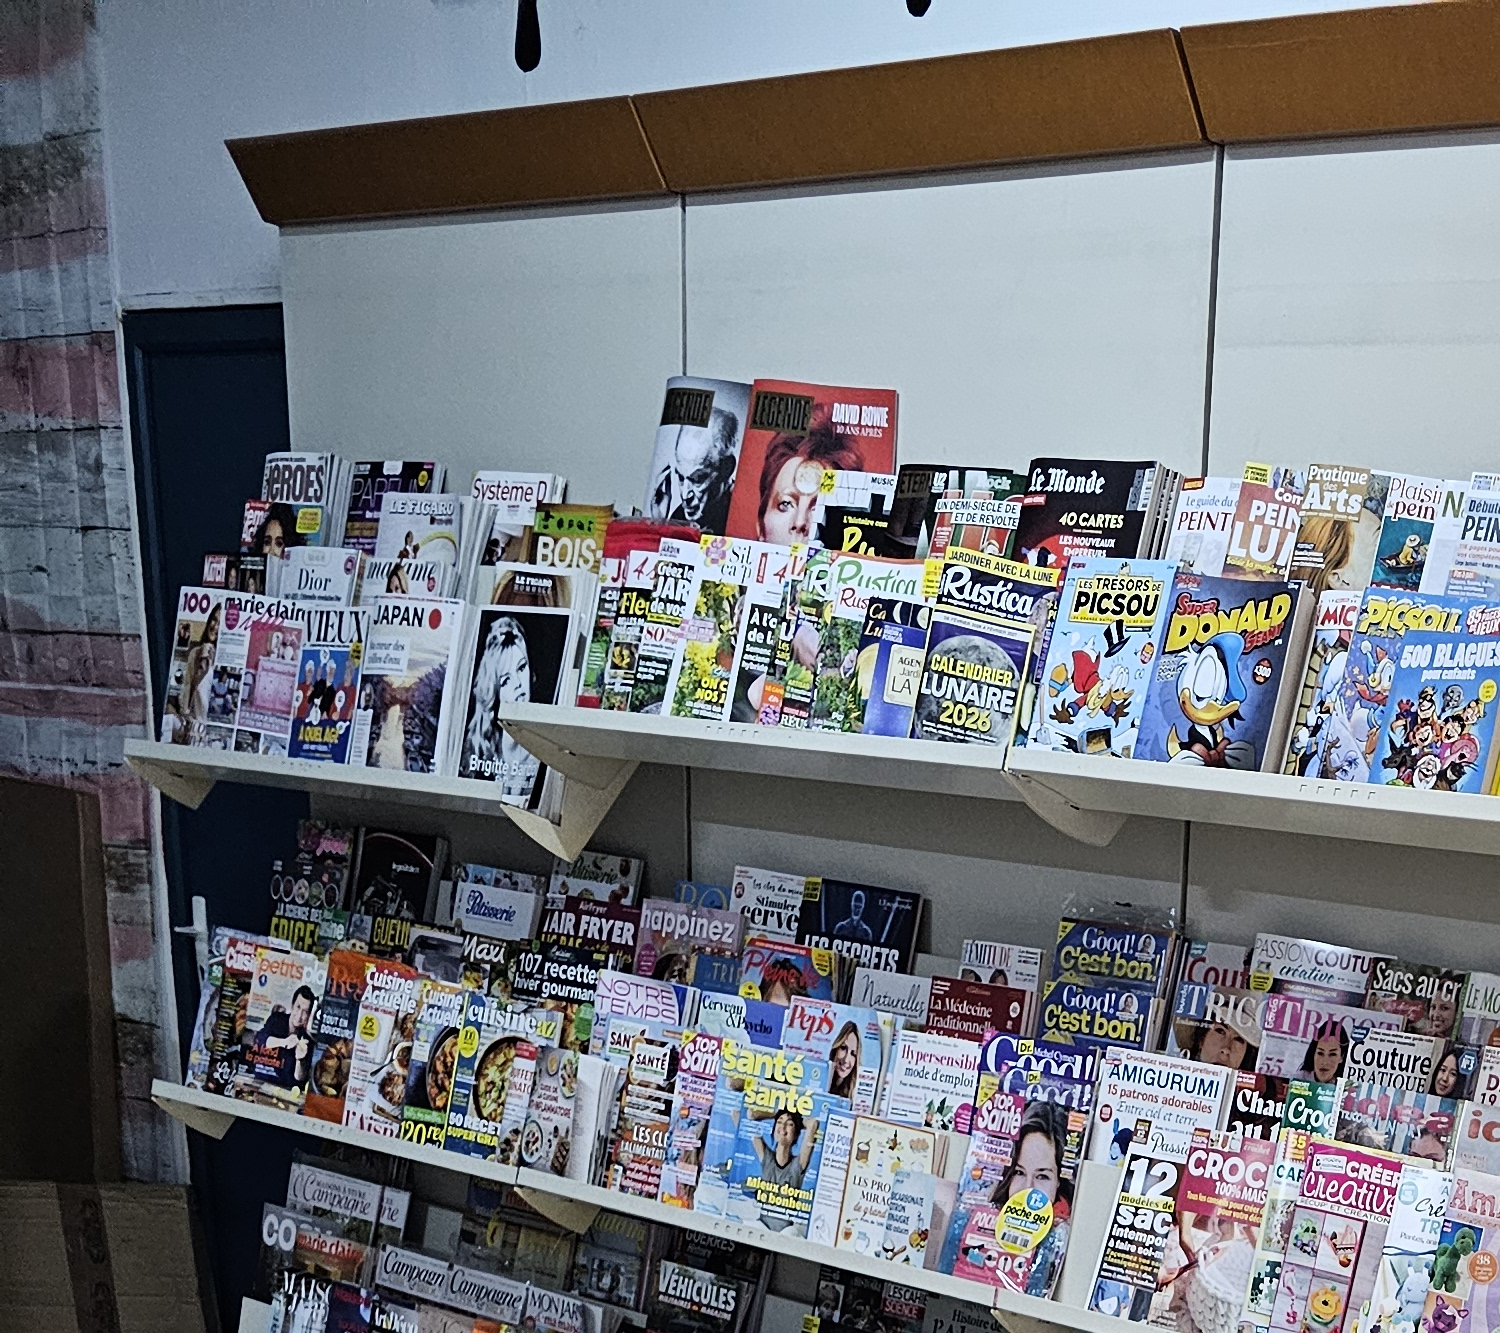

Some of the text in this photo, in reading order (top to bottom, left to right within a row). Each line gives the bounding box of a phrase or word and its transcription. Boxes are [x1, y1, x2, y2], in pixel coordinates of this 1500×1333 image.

[832, 403, 889, 428] DAVID BOWIE
[836, 425, 844, 433] 10
[846, 426, 859, 435] ANS
[871, 476, 894, 486] MUSIC
[1029, 467, 1105, 494] Le Monde
[1308, 464, 1368, 486] Pratique
[1323, 481, 1338, 493] des
[472, 478, 547, 501] Système D
[1302, 484, 1362, 513] Arts
[389, 499, 454, 516] LE FIGARO
[1059, 511, 1124, 529] 40 CARTES
[1073, 536, 1115, 549] NOUVEAUX
[298, 568, 331, 591] Dior
[949, 550, 1054, 583] JARDINER AVEC LA LUNE
[944, 566, 1034, 615] Rustica
[1079, 580, 1093, 590] LES
[182, 592, 210, 614] 100
[373, 605, 424, 628] JAPAN
[1073, 591, 1159, 616] PICSOU
[1176, 593, 1220, 616] SUPER
[306, 610, 367, 645] VIEUX
[1164, 592, 1292, 654] DONALD
[930, 654, 1013, 686] CALENDRIER
[1400, 644, 1432, 669] 500
[1421, 668, 1476, 682] pour enfants
[920, 672, 1016, 714] LUNAIRE
[940, 701, 992, 733] 2026
[640, 910, 735, 943] happinez
[1082, 925, 1137, 955] Good!
[1059, 945, 1162, 983] C'est bon!
[1278, 963, 1335, 985] créative
[366, 970, 414, 996] Cuisine
[599, 975, 674, 1005] NOTRE
[361, 985, 417, 1014] Actuelle
[599, 994, 678, 1025] TEMPS
[1062, 984, 1116, 1013] Good!
[468, 1001, 536, 1032] cuisine
[1044, 1007, 1142, 1043] C'est bon!
[635, 1051, 668, 1072] SANTÉ
[1349, 1041, 1432, 1074] Couture
[934, 1067, 975, 1089] d'emploi
[1108, 1063, 1220, 1099] AMIGURUMI
[744, 1082, 814, 1116] santé
[1120, 1086, 1213, 1114] patrons adorables
[1128, 1157, 1179, 1202] 12
[1004, 1204, 1031, 1221] poche
[449, 1269, 522, 1310] Campagne
[658, 1262, 737, 1312] VÉHICULES
